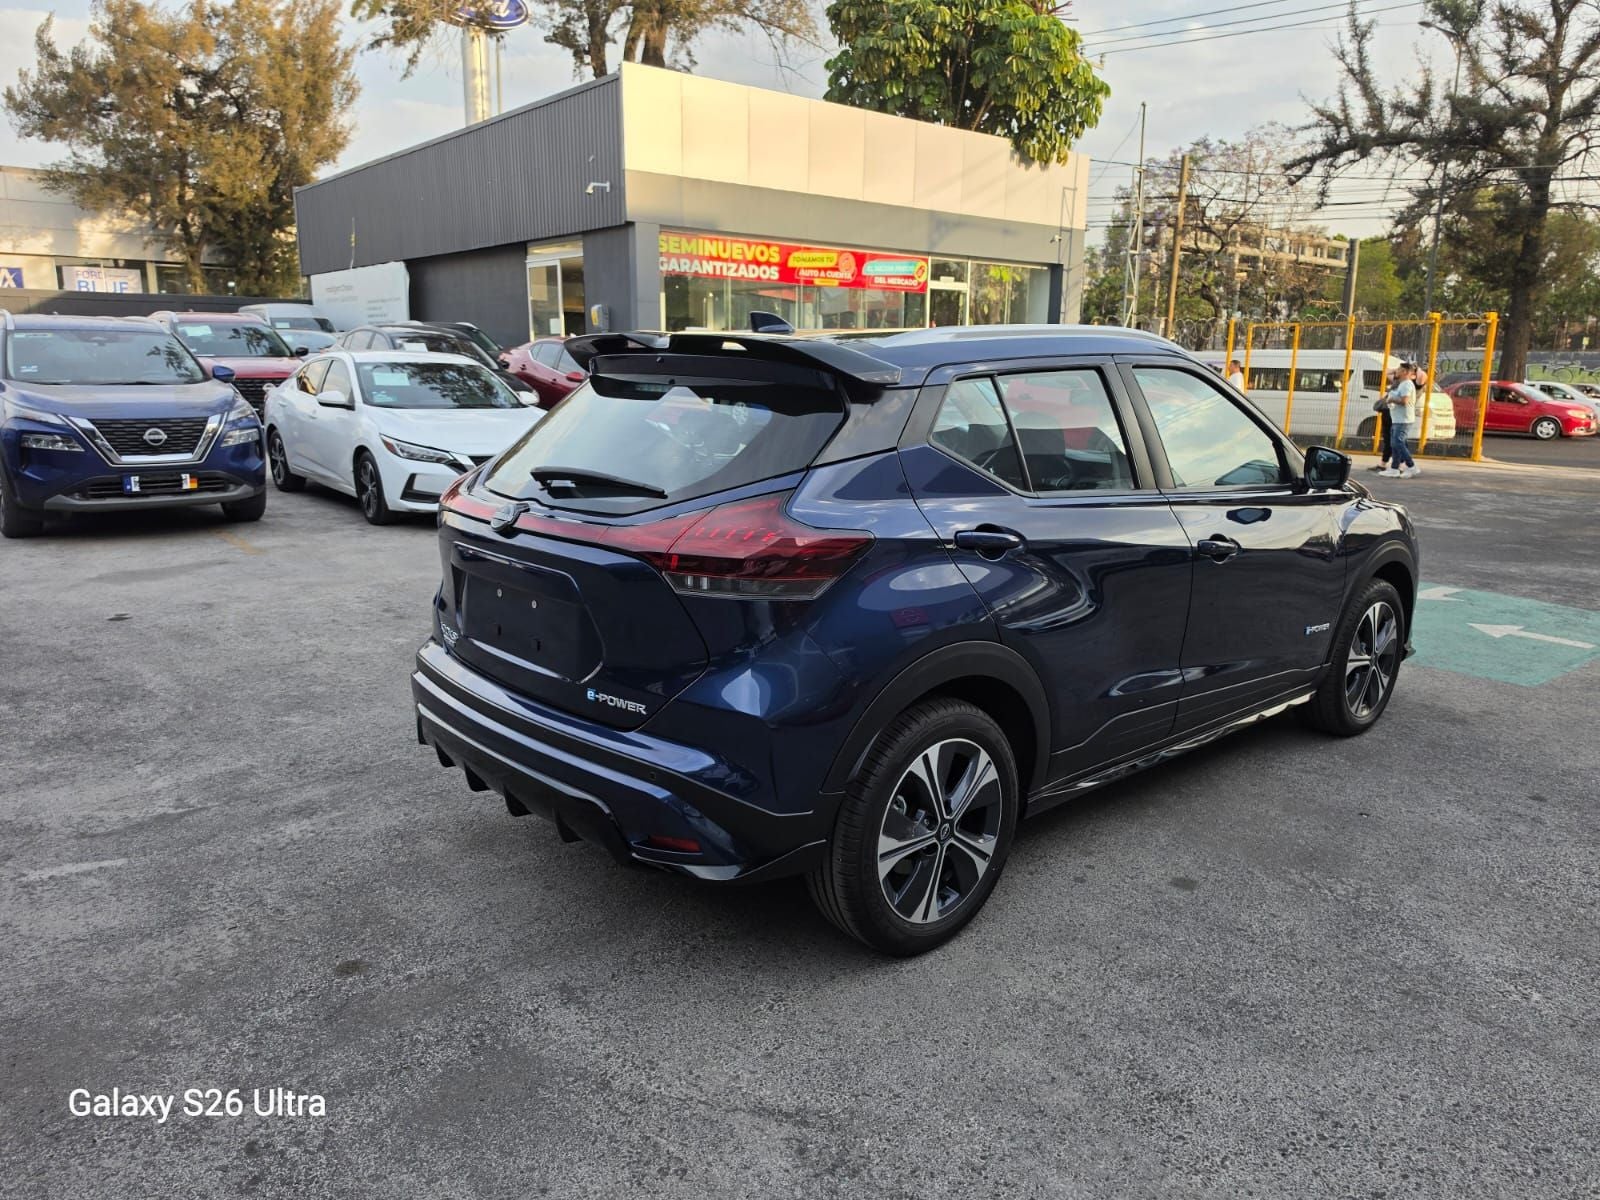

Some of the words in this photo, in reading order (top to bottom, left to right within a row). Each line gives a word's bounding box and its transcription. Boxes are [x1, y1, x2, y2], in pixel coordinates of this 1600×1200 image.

[658, 234, 781, 263] SEMINUEVOS
[658, 256, 780, 281] GARANTIZADOS
[586, 688, 648, 716] e-POWER
